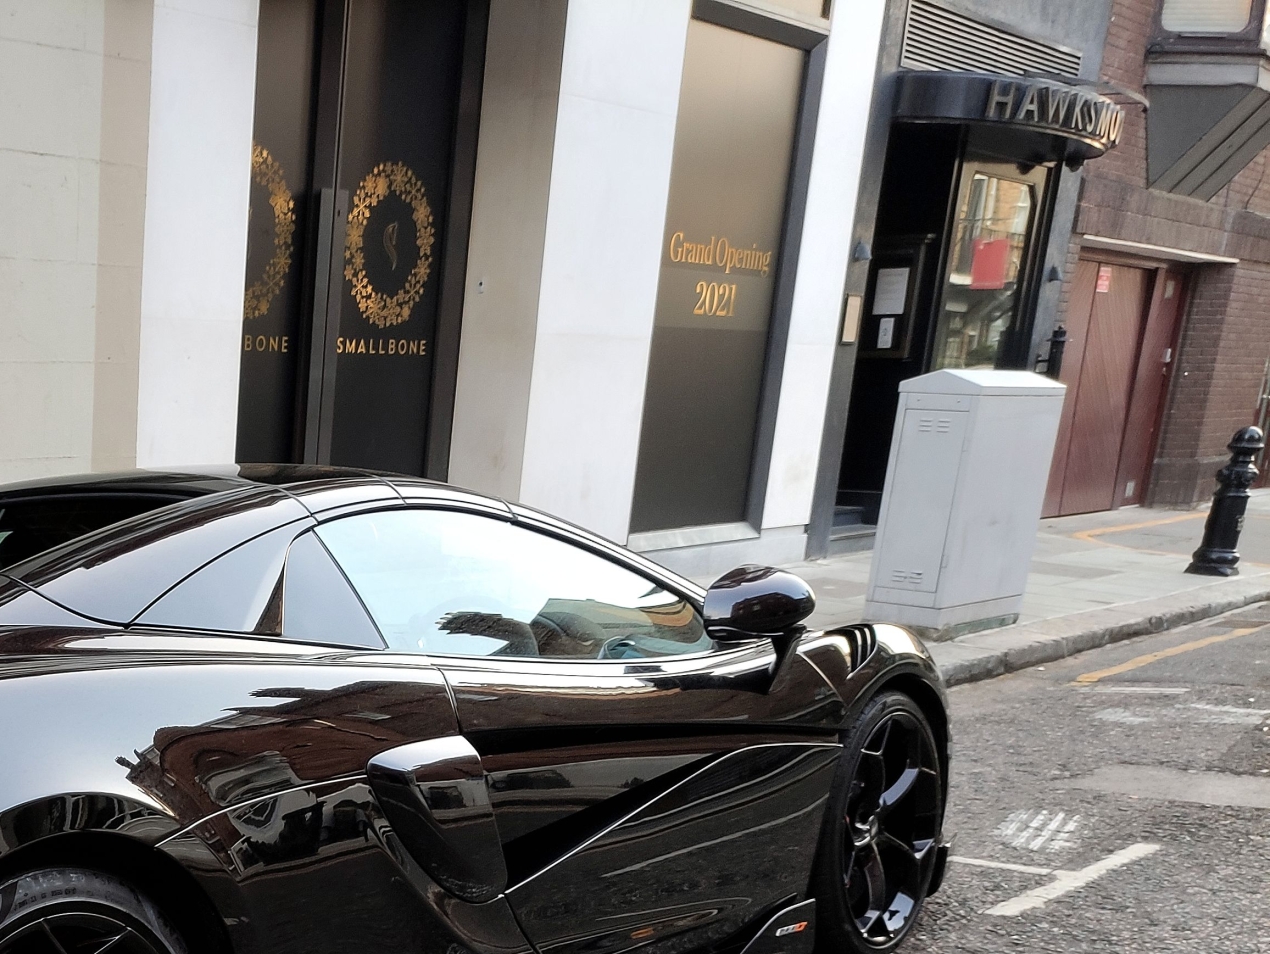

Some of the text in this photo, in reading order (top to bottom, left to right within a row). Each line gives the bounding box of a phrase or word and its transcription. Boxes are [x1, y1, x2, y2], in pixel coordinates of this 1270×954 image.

[670, 231, 772, 278] Grand Opening
[693, 281, 737, 317] 2021
[336, 337, 427, 356] SMALLBONE
